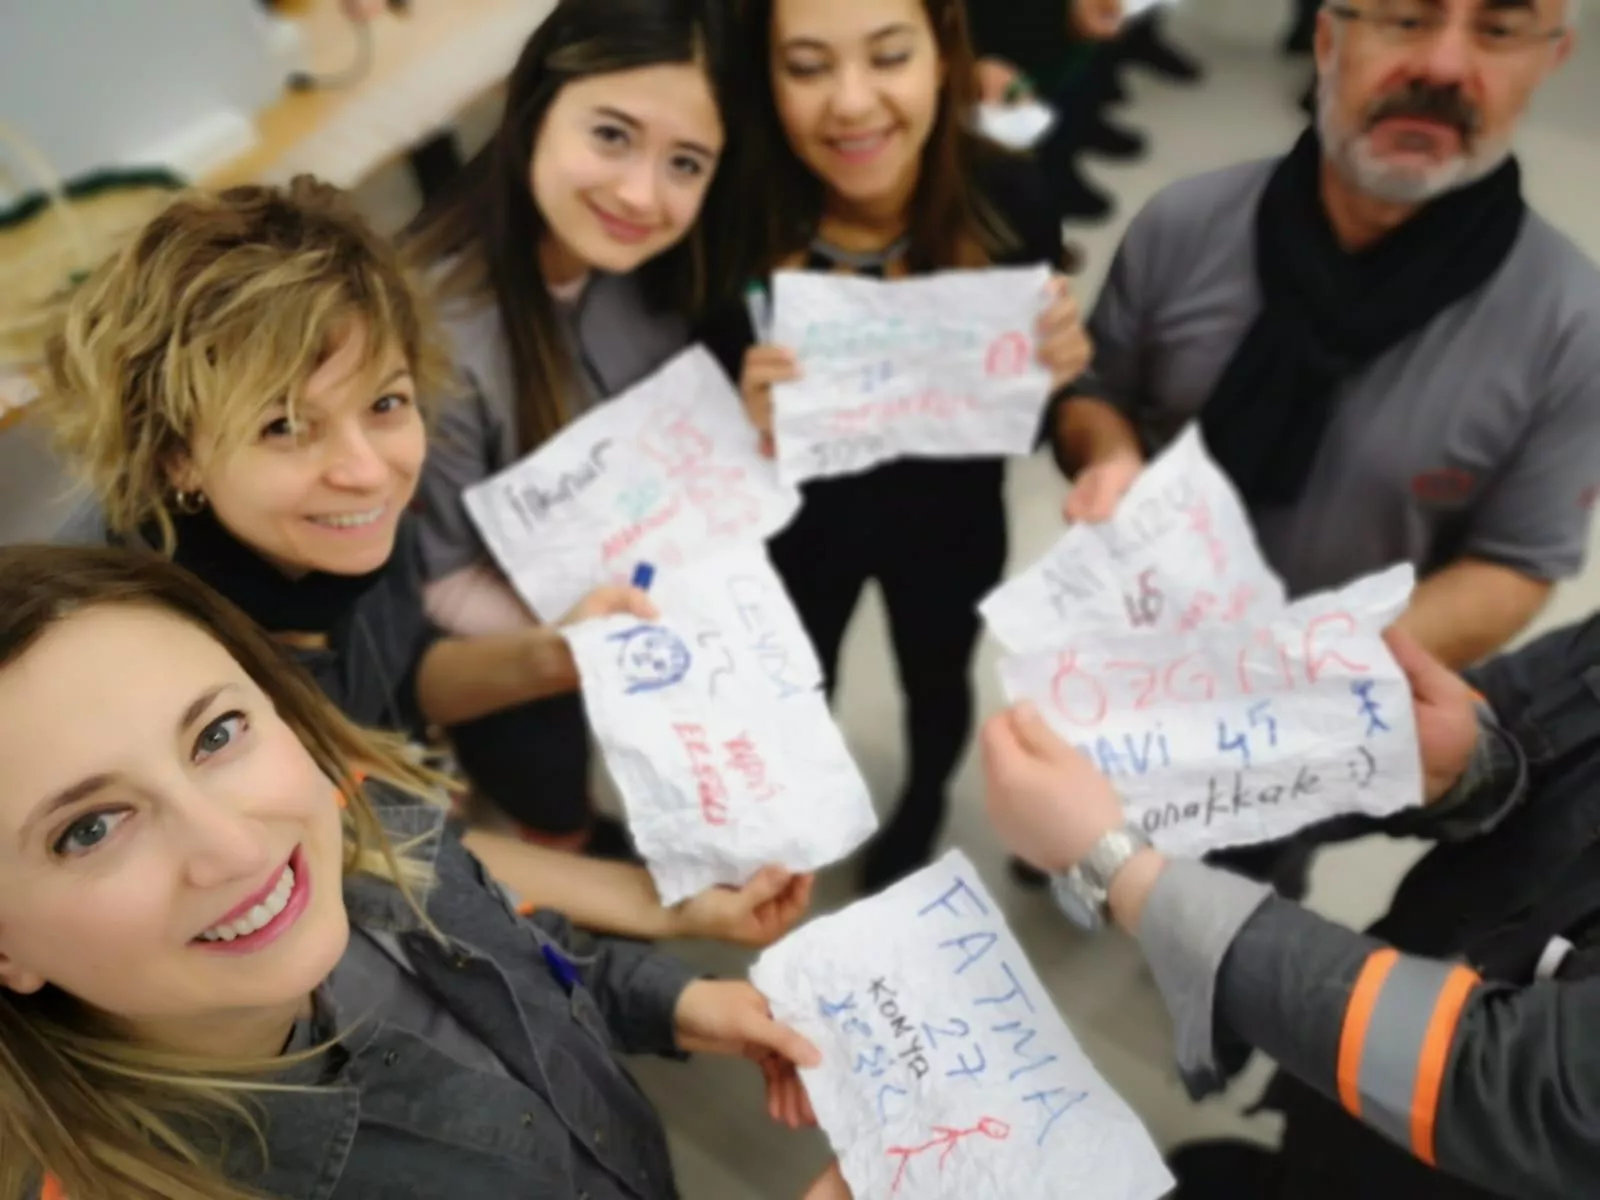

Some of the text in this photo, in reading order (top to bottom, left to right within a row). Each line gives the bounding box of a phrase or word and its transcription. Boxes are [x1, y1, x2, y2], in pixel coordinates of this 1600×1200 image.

[1078, 700, 1279, 777] AVi 45
[1141, 763, 1321, 833] anakkale
[917, 875, 1090, 1147] FATMA
[920, 1016, 988, 1081] 27
